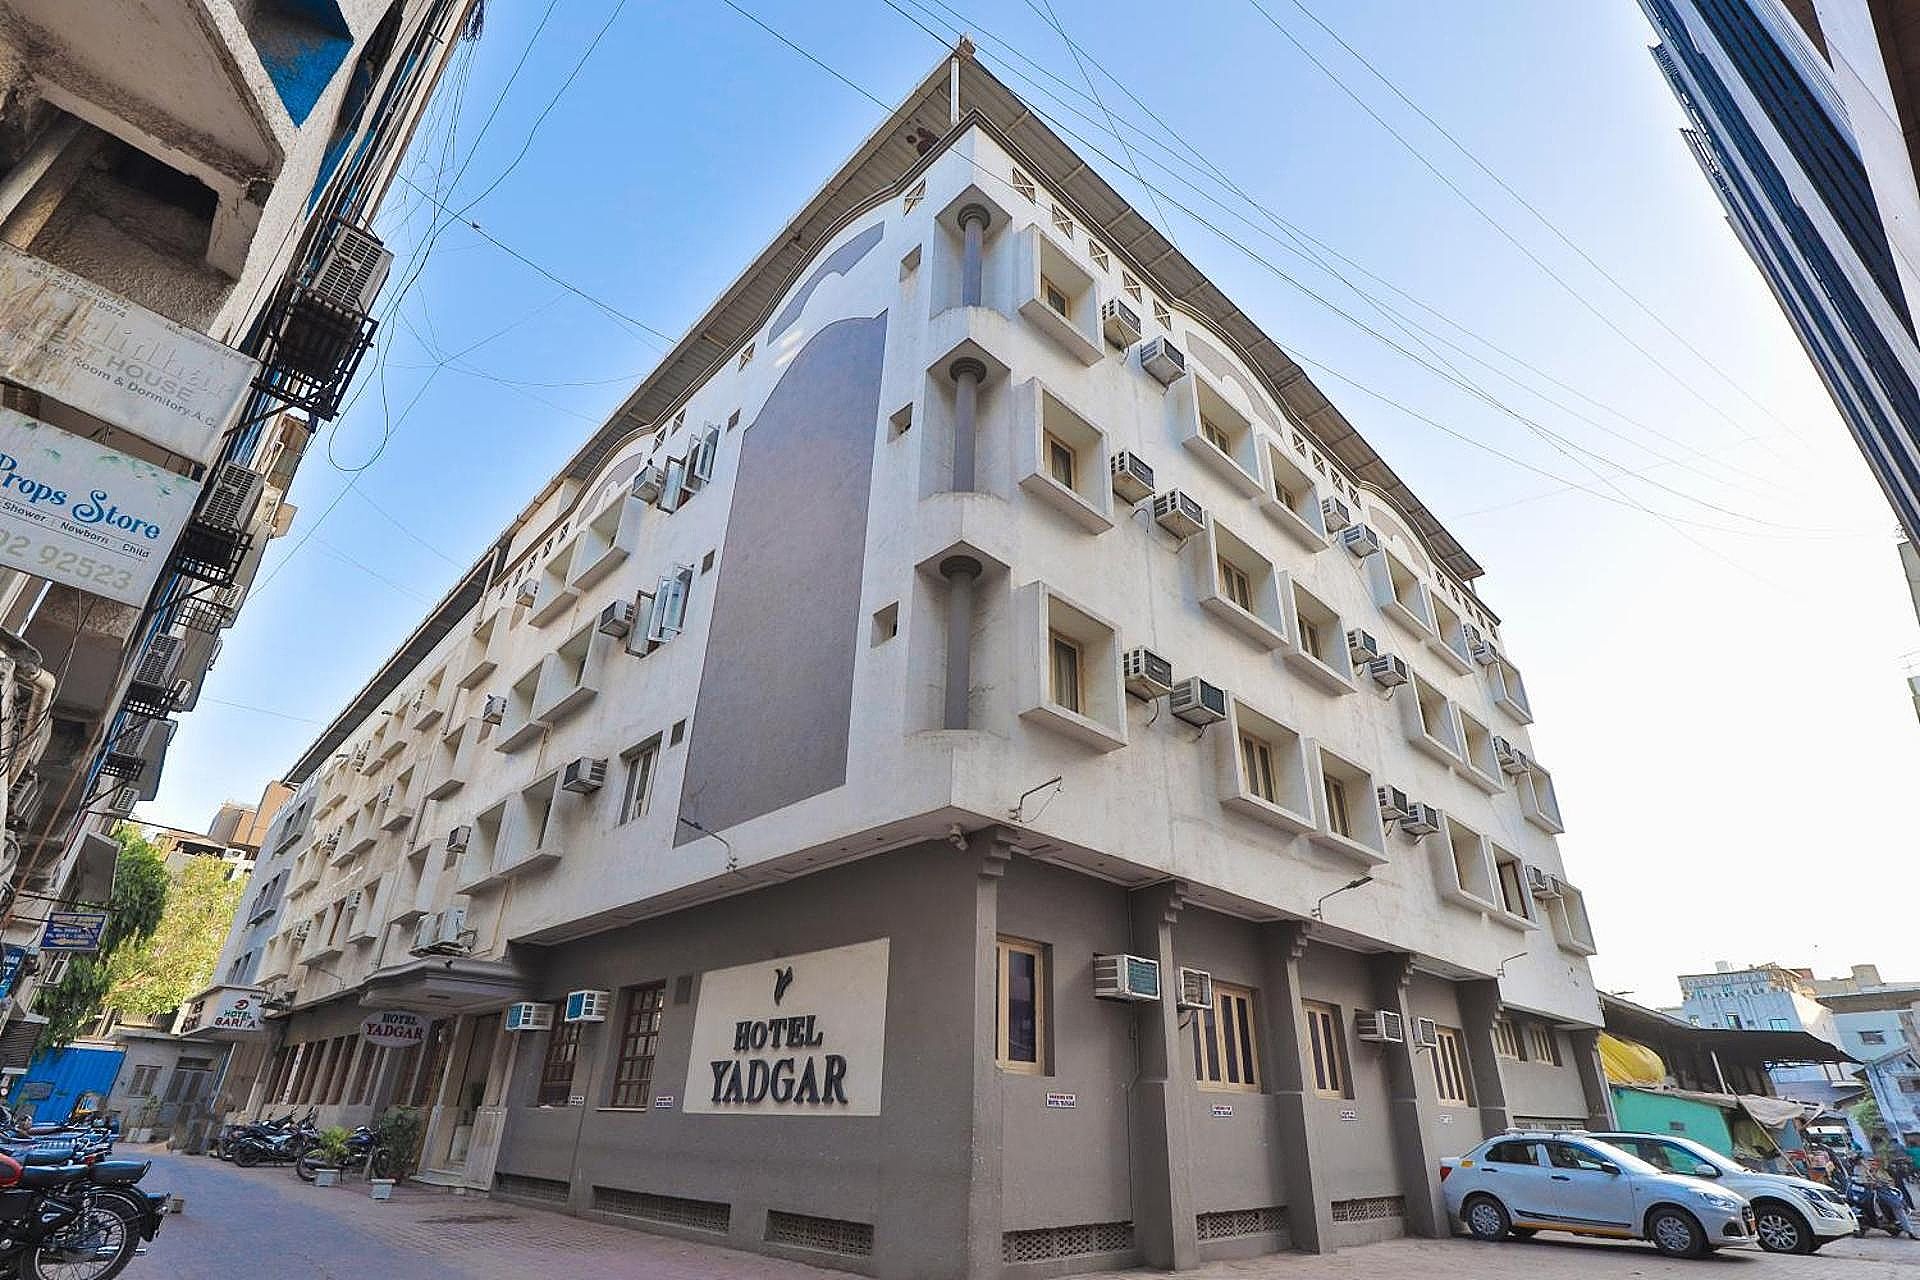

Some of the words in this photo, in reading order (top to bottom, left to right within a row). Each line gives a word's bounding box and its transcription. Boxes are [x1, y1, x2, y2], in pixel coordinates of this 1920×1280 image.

[106, 355, 194, 402] HOUSE
[113, 376, 125, 389] &
[0, 452, 68, 508] Props
[71, 489, 160, 541] Store
[36, 543, 133, 592] 92523
[366, 1022, 425, 1040] YADGAR
[381, 1013, 418, 1026] HOTEL
[733, 1014, 824, 1052] HOTEL
[710, 1054, 849, 1105] YADGAR
